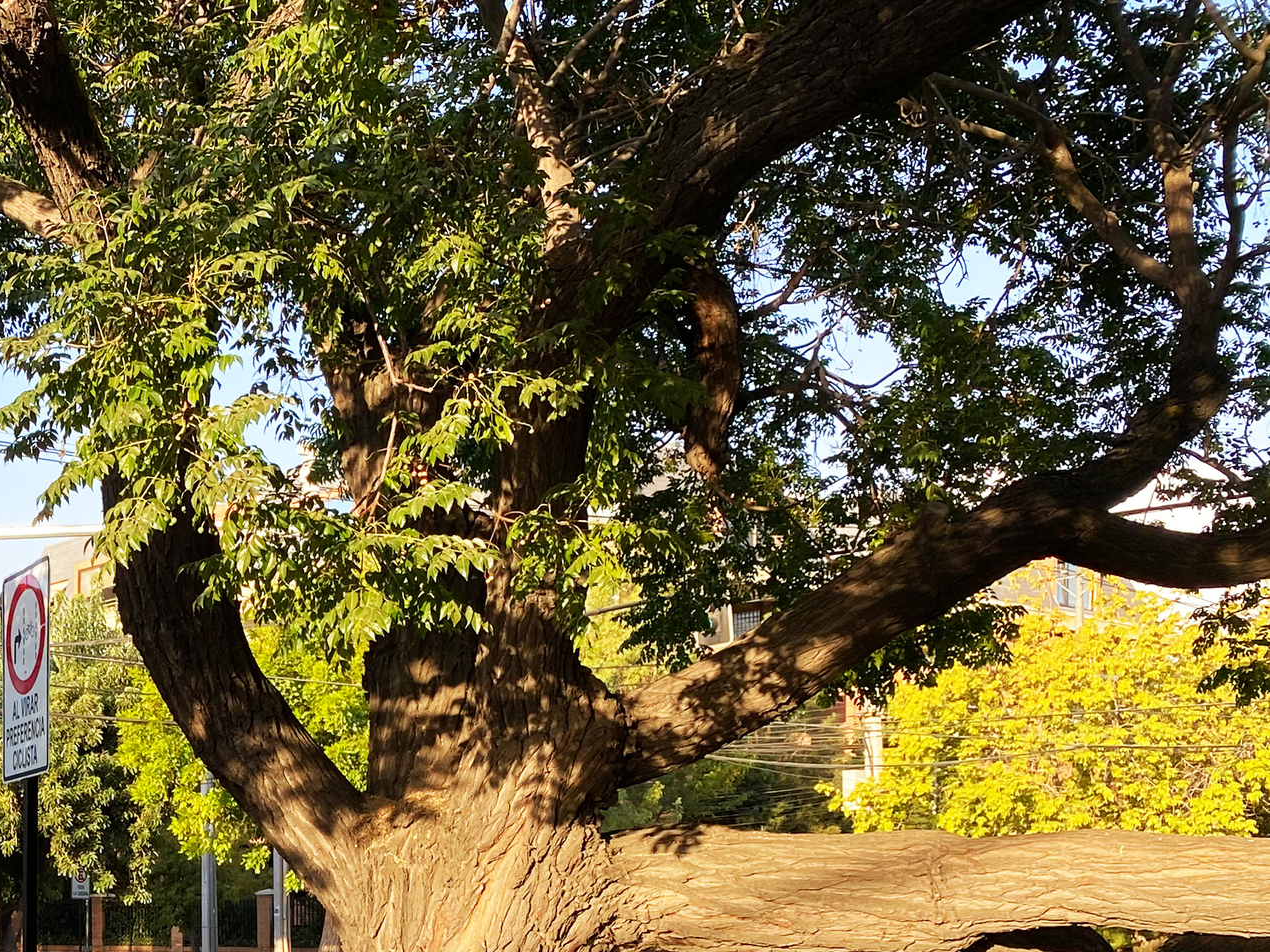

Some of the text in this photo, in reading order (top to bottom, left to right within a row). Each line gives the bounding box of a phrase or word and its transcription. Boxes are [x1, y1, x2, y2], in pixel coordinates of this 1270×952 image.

[12, 693, 39, 721] AL VIRAR
[6, 716, 45, 748] PREFERENCIA
[12, 744, 38, 770] CICLISTA
